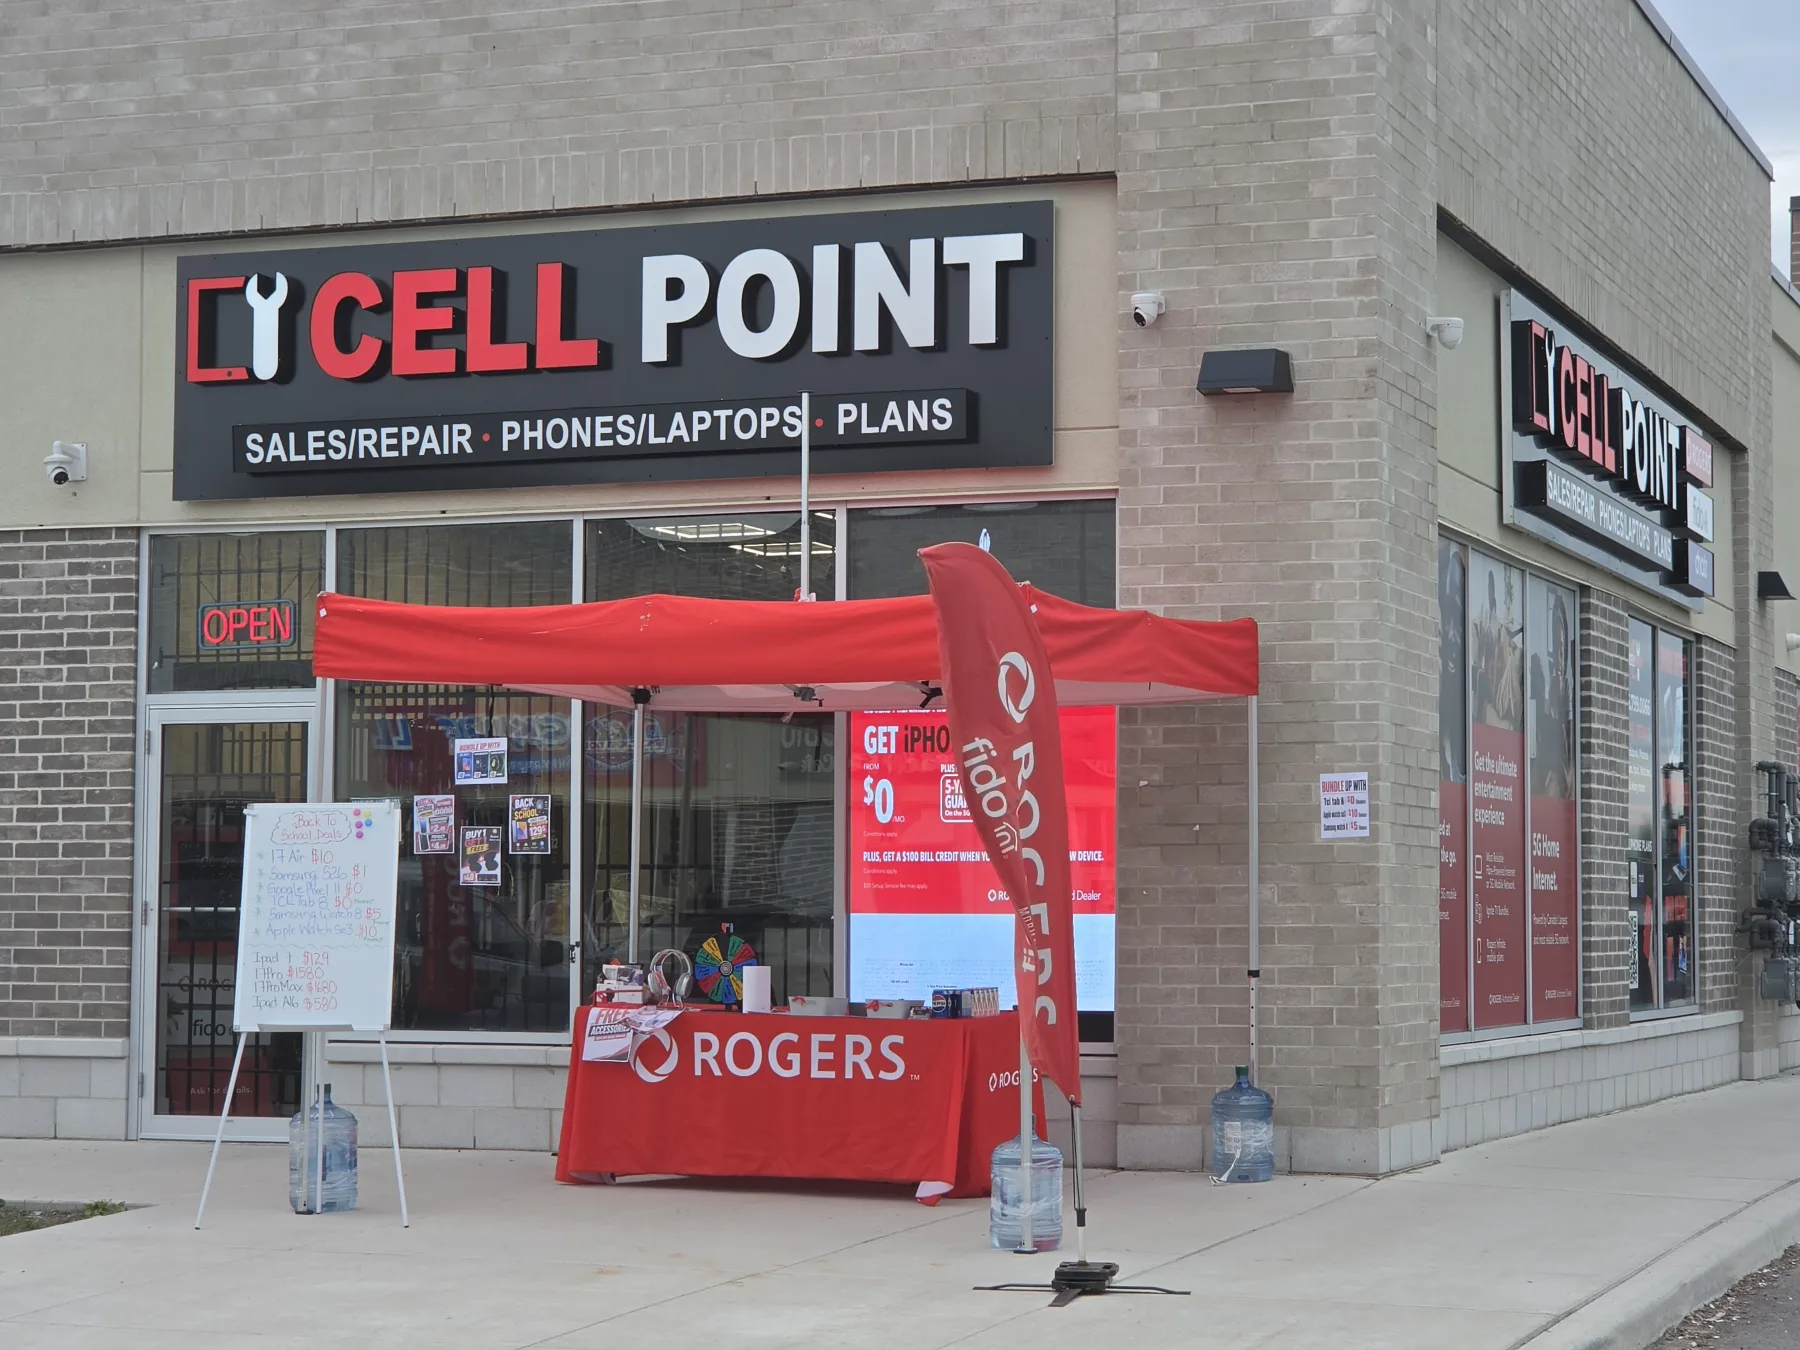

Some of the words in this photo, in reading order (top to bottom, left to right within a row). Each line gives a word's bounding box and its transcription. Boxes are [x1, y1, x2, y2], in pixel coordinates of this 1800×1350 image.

[309, 262, 598, 379] CELL
[641, 232, 1023, 363] POINT
[245, 423, 473, 464] SALES/REPAIR
[501, 405, 802, 452] PHONES/LAPTOPS
[837, 398, 953, 435] PLANS
[1561, 346, 1615, 474] CELL
[1622, 388, 1679, 510] POINT
[1548, 470, 1595, 522] SALES/REPAIR
[1599, 500, 1650, 552] PHONES/LAPTOPS
[1653, 530, 1672, 564] PLANS
[204, 606, 290, 644] OPEN
[863, 725, 899, 755] GET
[903, 724, 951, 753] iPHO
[940, 764, 955, 772] PLUS
[1474, 751, 1485, 772] Get
[1485, 751, 1495, 773] the
[1495, 754, 1517, 778] ultimate
[962, 737, 1009, 817] fido
[1322, 781, 1344, 793] BUNDLE
[1345, 780, 1353, 792] UP
[1353, 779, 1367, 792] WITH
[1474, 779, 1513, 802] entertainment
[514, 797, 535, 809] BACK
[863, 775, 894, 824] $0
[1346, 795, 1355, 805] $0
[293, 813, 321, 828] Back
[324, 813, 337, 826] To
[514, 809, 539, 820] SCHOOL
[1474, 804, 1505, 829] experience
[281, 829, 312, 841] School
[314, 828, 342, 840] Deals
[465, 829, 482, 840] BUY
[1350, 821, 1358, 831] $5
[470, 845, 485, 853] FREE
[1532, 832, 1541, 857] 5G
[1542, 833, 1560, 858] Home
[271, 849, 285, 864] 17
[288, 849, 305, 864] Air
[312, 848, 334, 865] $10
[863, 851, 882, 862] PLUS,
[882, 851, 895, 861] GET
[896, 851, 902, 861] A
[902, 851, 919, 861] $100
[920, 851, 934, 861] BILL
[935, 851, 959, 861] CREDIT
[959, 851, 980, 861] WHEN
[1077, 850, 1105, 862] DEVICE.
[268, 866, 317, 883] Samsung
[1532, 866, 1558, 891] Internet.
[268, 882, 305, 897] Google
[306, 881, 329, 897] Pixel
[345, 881, 363, 897] $0
[1076, 890, 1102, 900] Dealer
[297, 896, 315, 908] Tab
[318, 896, 329, 910] 8
[335, 895, 353, 910] $0
[270, 907, 317, 923] Samsung
[320, 909, 353, 920] Watch
[355, 907, 363, 920] 8
[364, 906, 381, 920] $5
[265, 922, 295, 941] Apple
[252, 951, 280, 968] Ipad
[302, 950, 329, 967] $129
[287, 964, 325, 981] $1580
[306, 979, 338, 996] $1680
[251, 995, 278, 1012] Ipad
[303, 996, 338, 1012] $580
[693, 1031, 906, 1081] ROGERS
[999, 1067, 1038, 1089] ROGS
